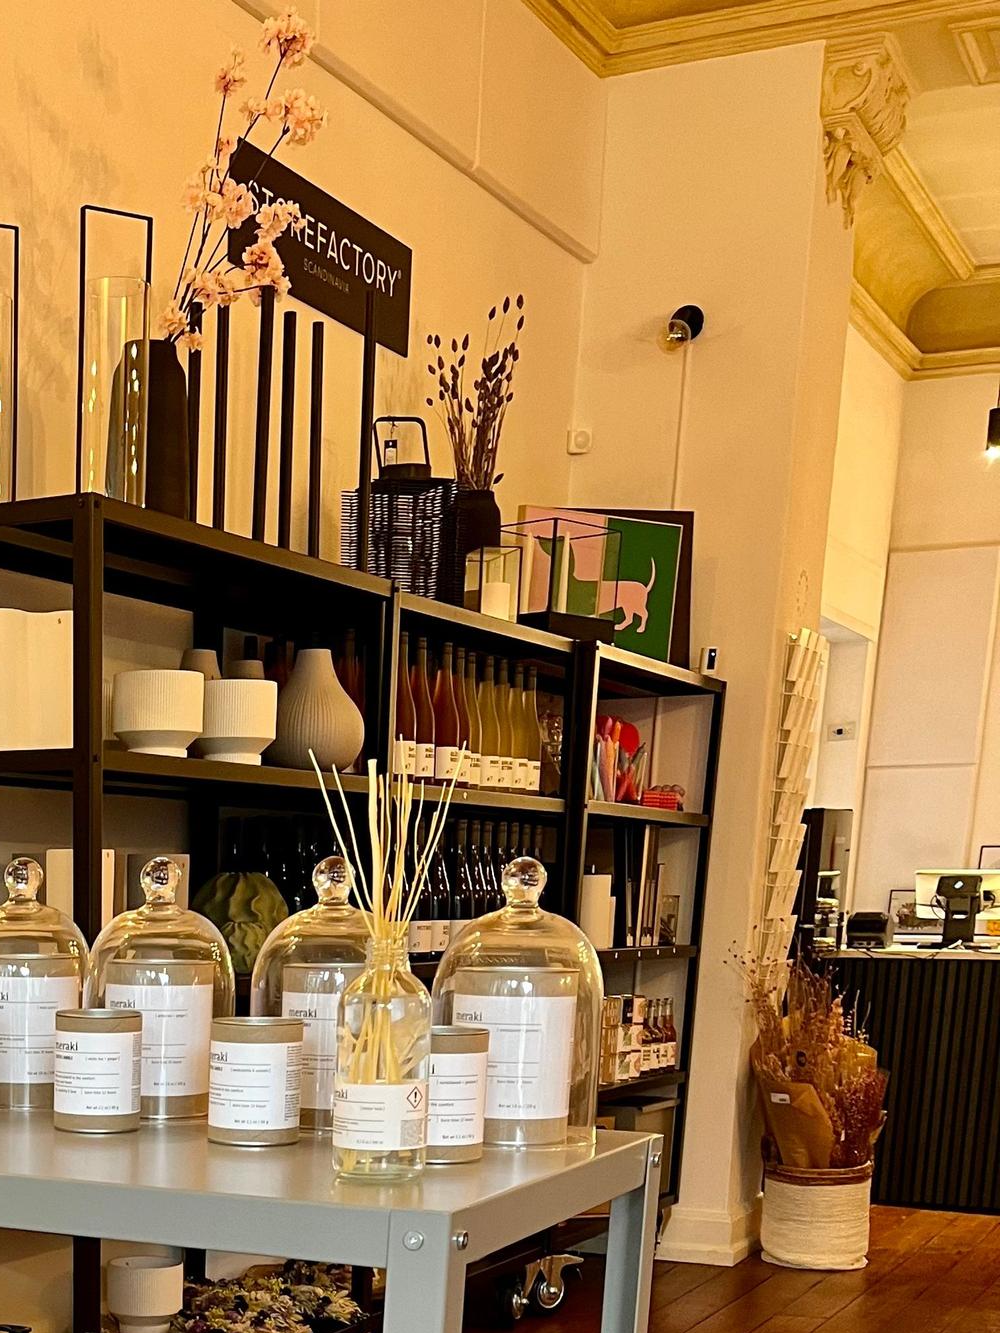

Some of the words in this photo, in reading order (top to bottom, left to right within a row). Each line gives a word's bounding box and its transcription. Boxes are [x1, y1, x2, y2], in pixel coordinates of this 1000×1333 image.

[249, 180, 398, 297] STEFACTORY
[304, 258, 349, 293] SCANDINAVIA
[110, 1000, 135, 1008] meraki
[288, 1008, 317, 1018] meraki
